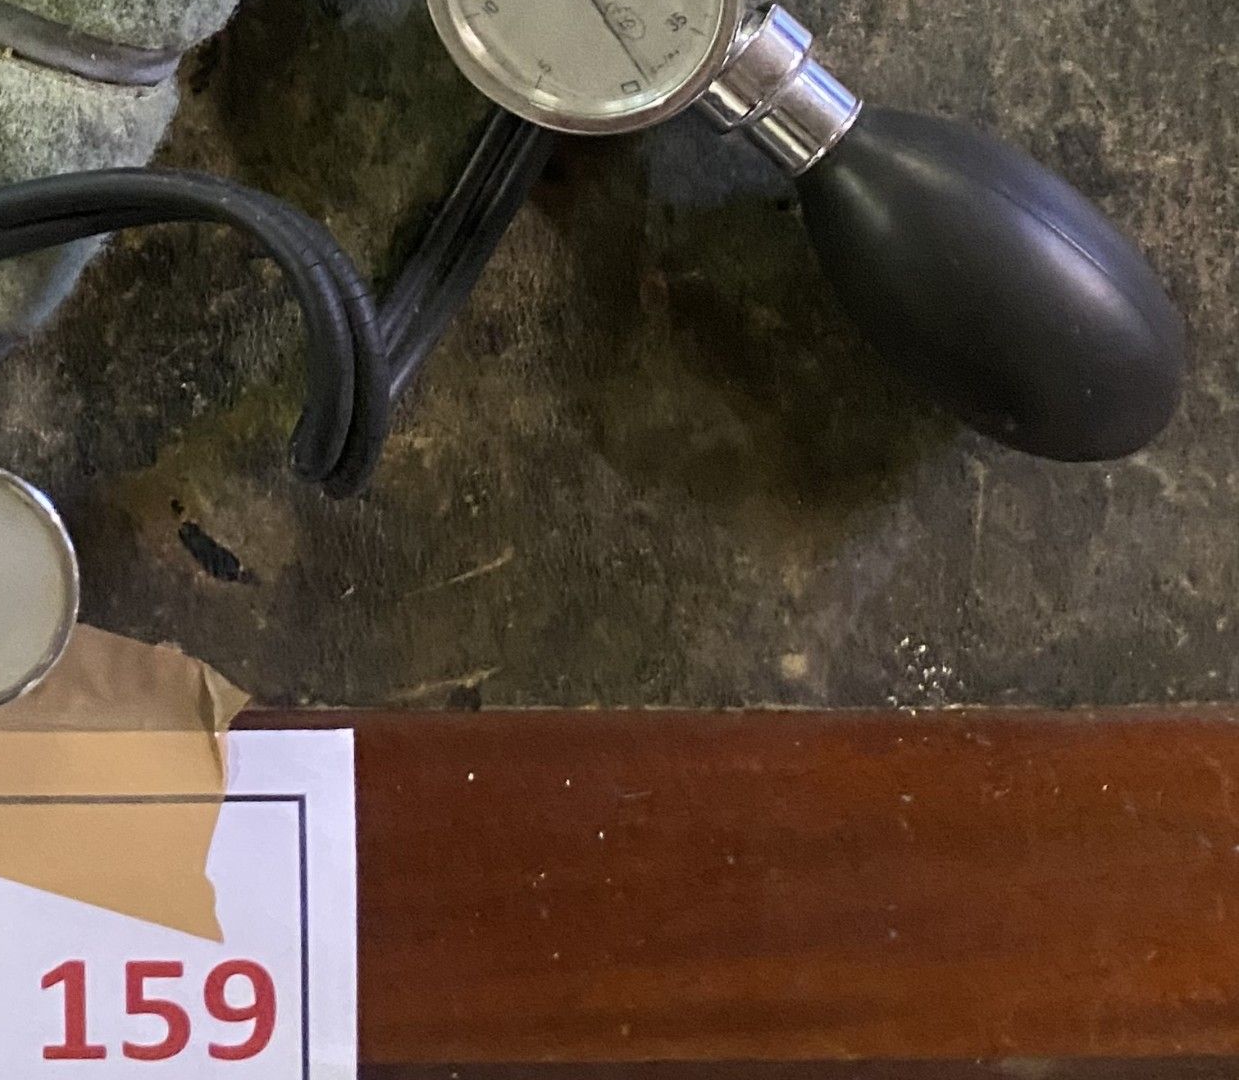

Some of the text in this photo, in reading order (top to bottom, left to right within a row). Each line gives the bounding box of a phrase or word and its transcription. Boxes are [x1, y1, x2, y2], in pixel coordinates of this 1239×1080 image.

[482, 0, 501, 18] 10
[666, 11, 689, 32] 35
[537, 59, 552, 75] 5
[39, 958, 277, 1063] 159
